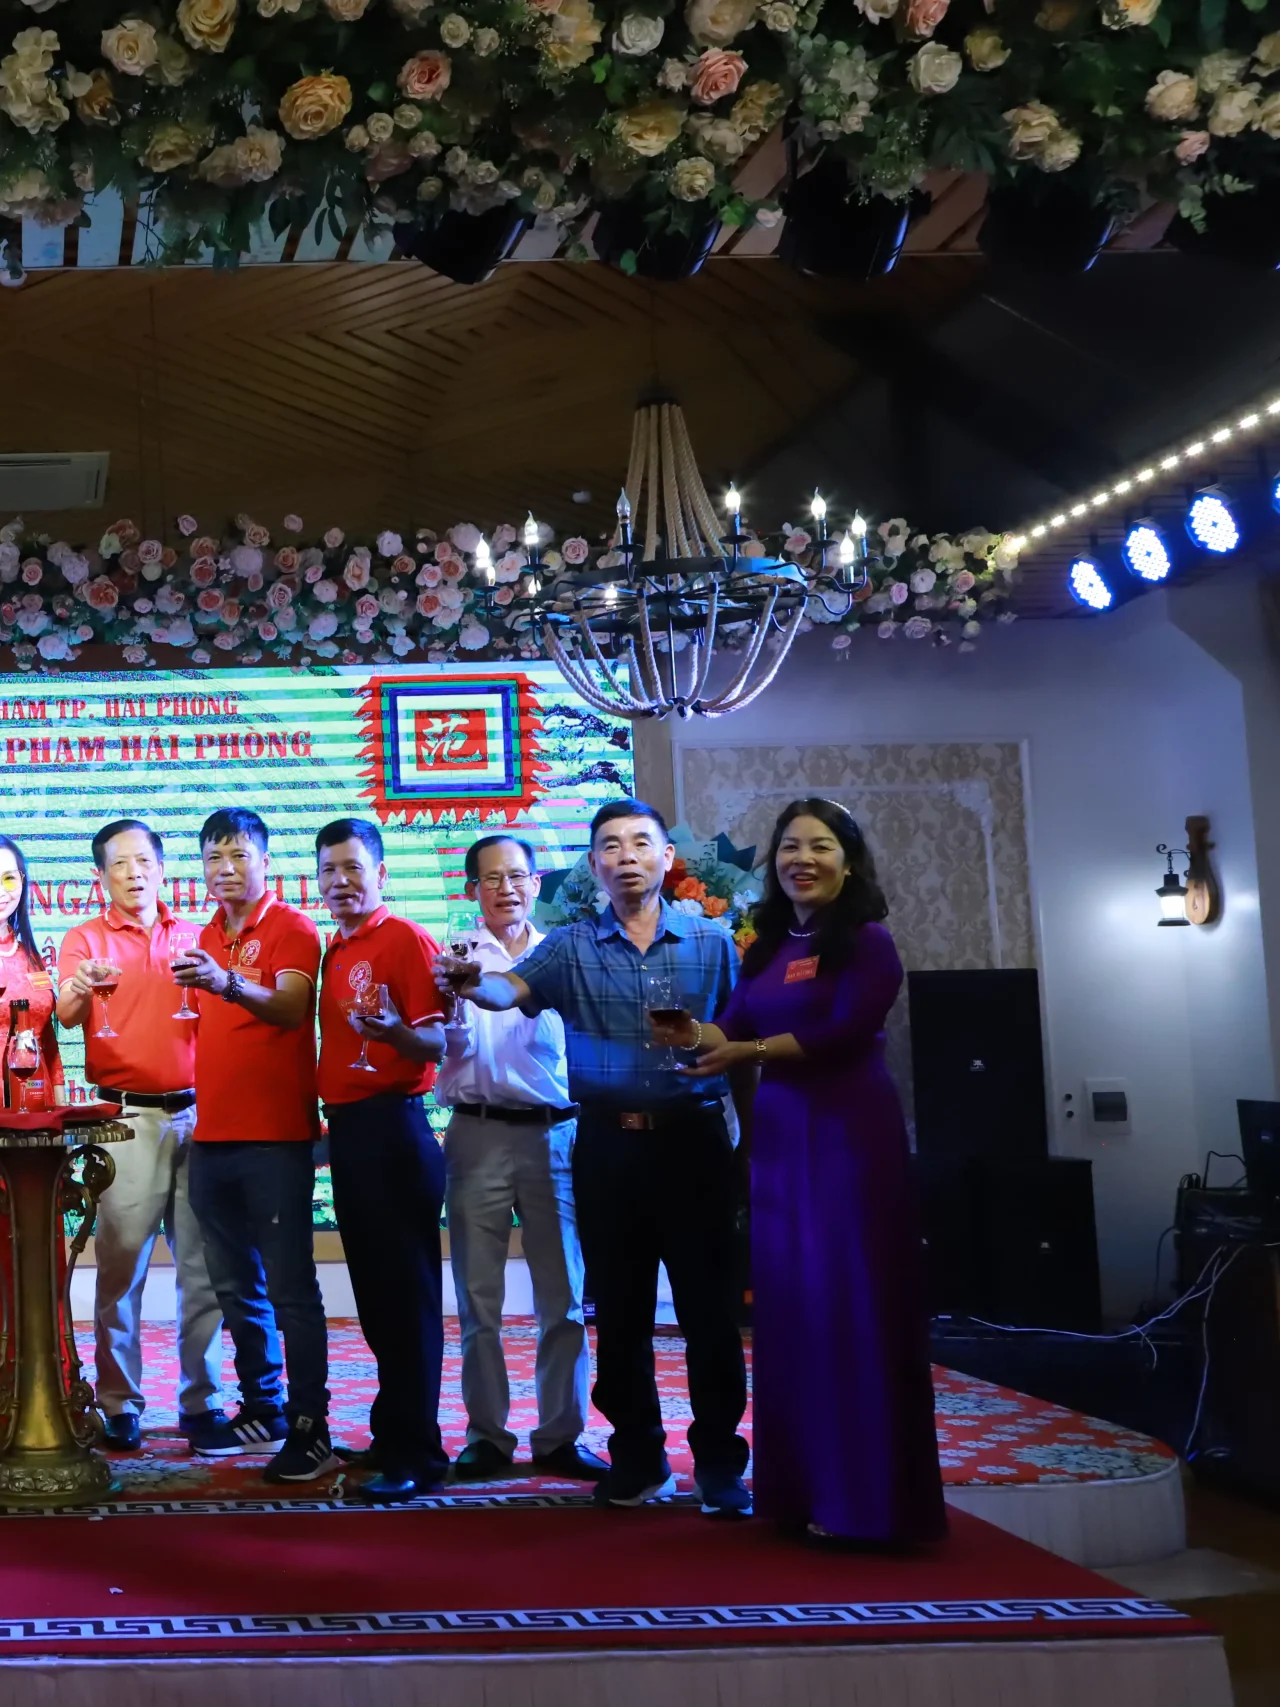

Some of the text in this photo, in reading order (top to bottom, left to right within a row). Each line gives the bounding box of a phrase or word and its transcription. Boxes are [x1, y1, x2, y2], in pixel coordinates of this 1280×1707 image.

[4, 736, 107, 767] PHẠM
[120, 727, 181, 762] HẢI
[193, 725, 313, 761] PHÒNG
[29, 867, 110, 916] NGÀ
